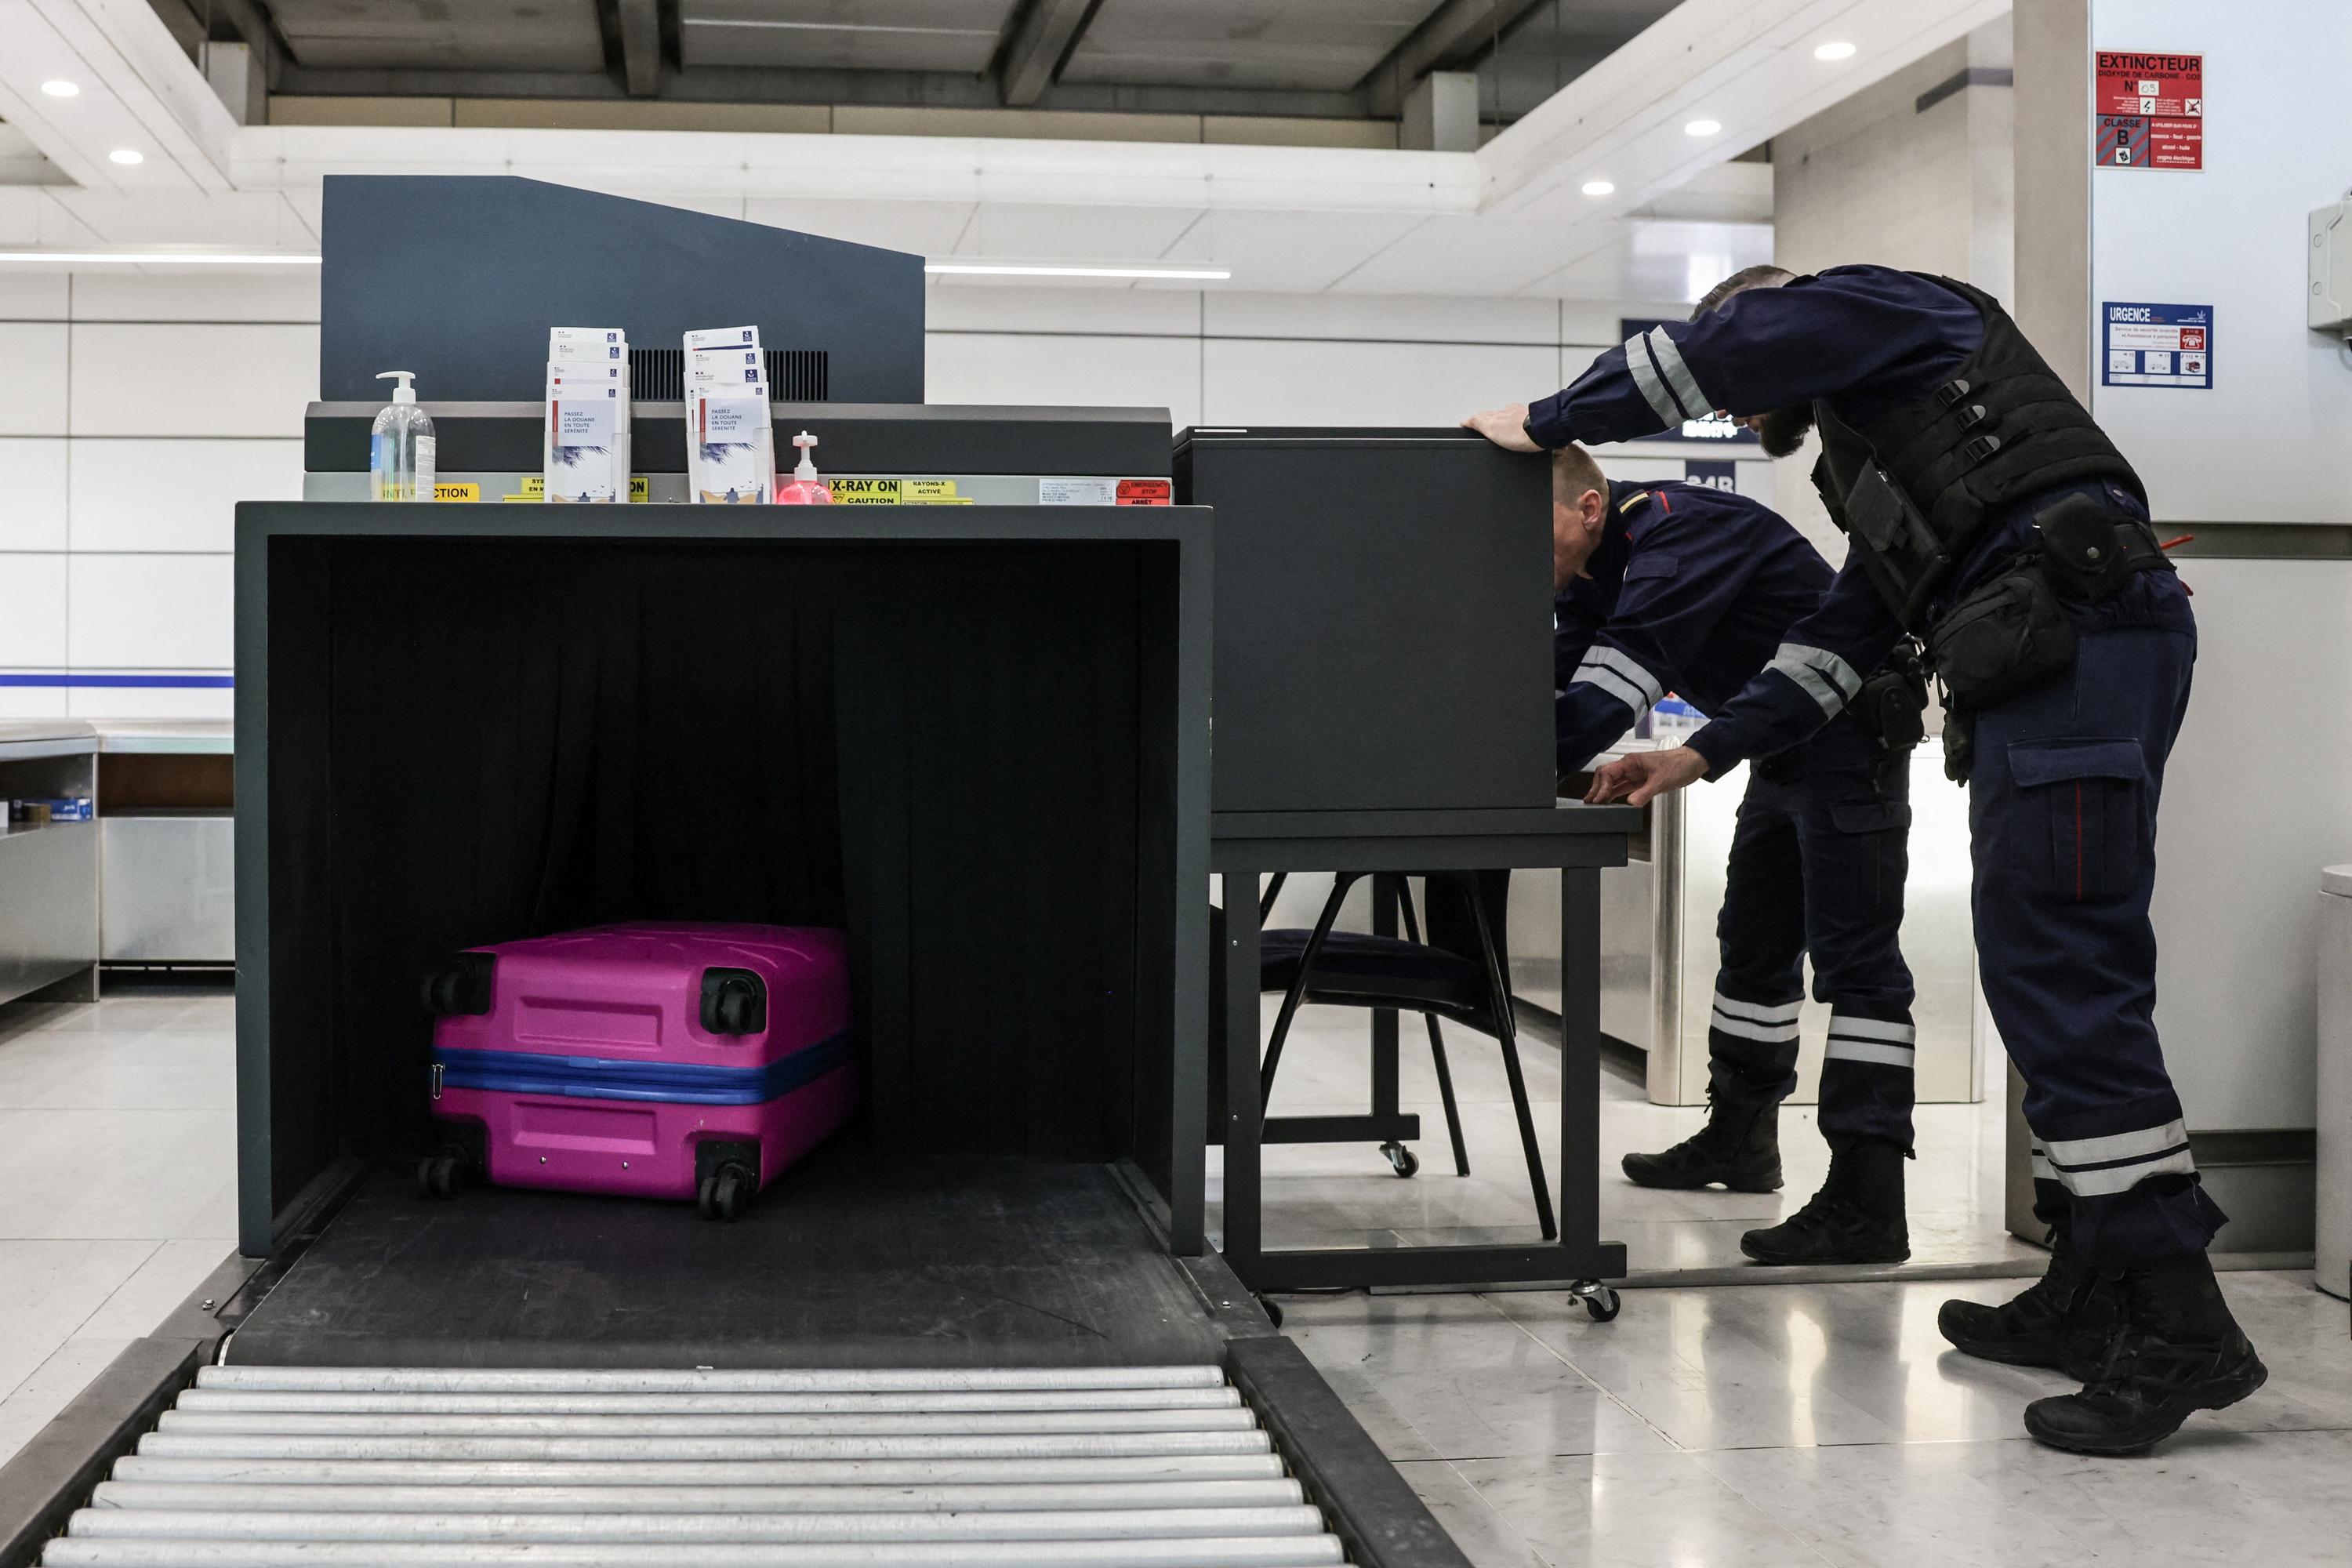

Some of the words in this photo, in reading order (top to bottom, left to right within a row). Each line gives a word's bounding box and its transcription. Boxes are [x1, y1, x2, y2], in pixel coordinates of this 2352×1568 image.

[2100, 54, 2199, 71] EXTINCTEUR
[2103, 118, 2141, 128] CLASSE
[2118, 129, 2129, 145] B
[2110, 307, 2151, 322] URGENCE
[832, 481, 874, 492] X-RAY
[877, 481, 898, 492] ON
